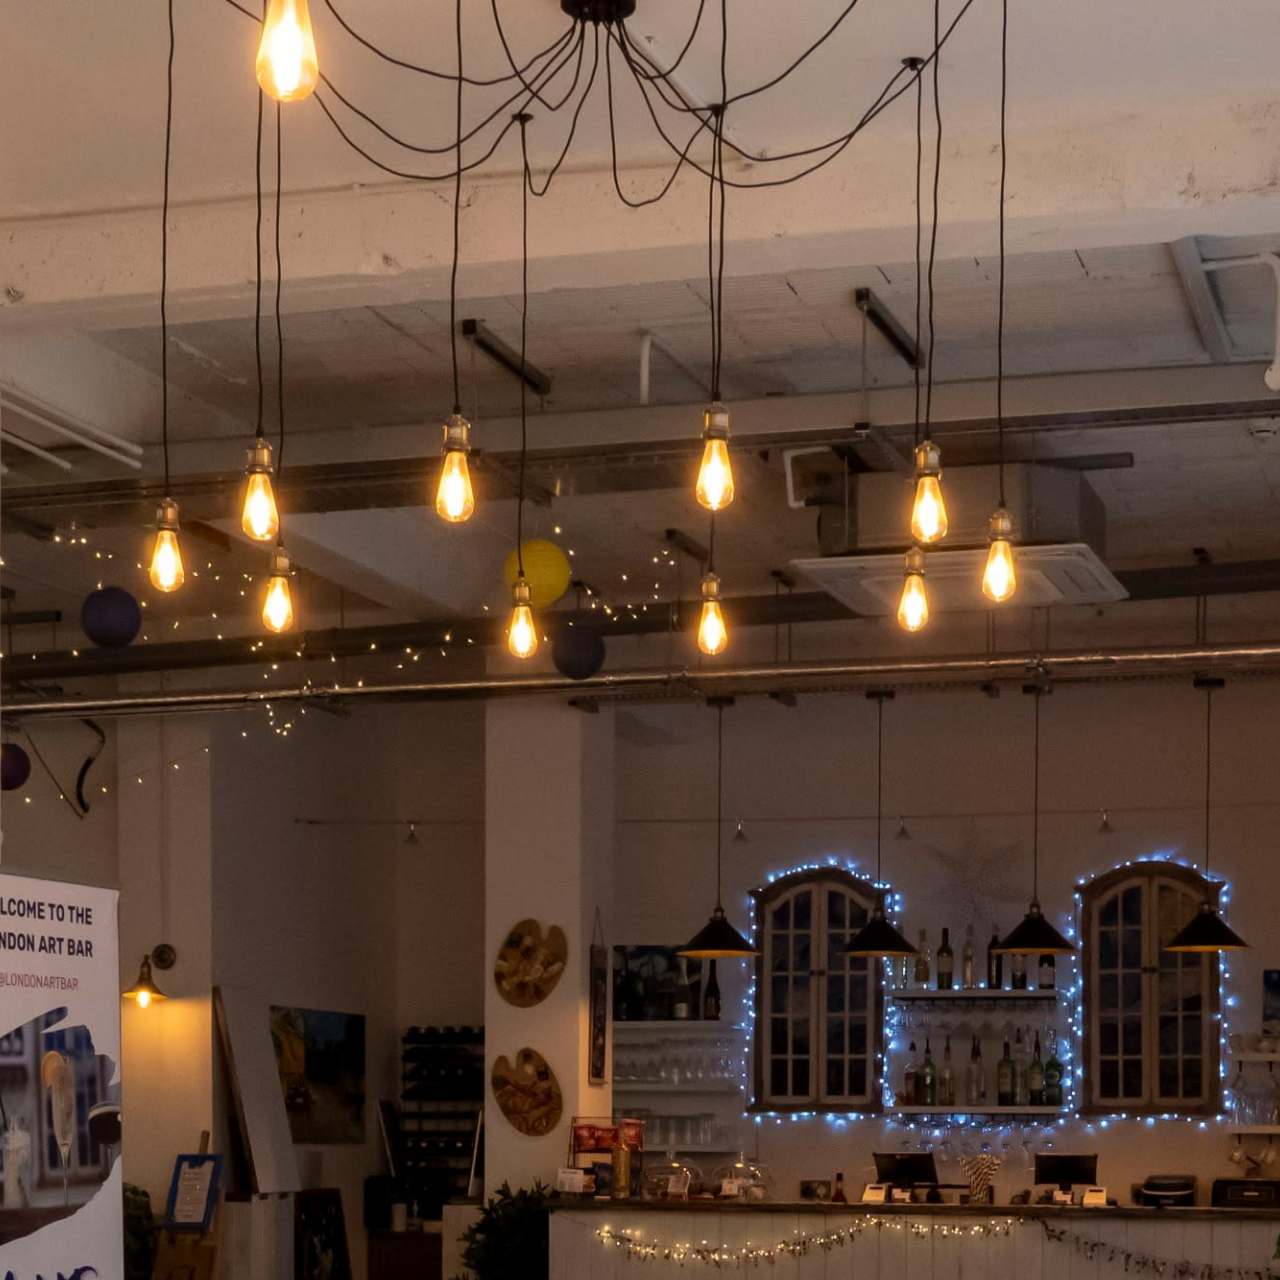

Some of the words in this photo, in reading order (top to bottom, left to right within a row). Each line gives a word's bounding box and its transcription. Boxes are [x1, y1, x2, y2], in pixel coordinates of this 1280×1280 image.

[48, 903, 65, 922] TO
[68, 905, 92, 925] THE
[39, 935, 64, 955] ART
[67, 938, 93, 958] BAR
